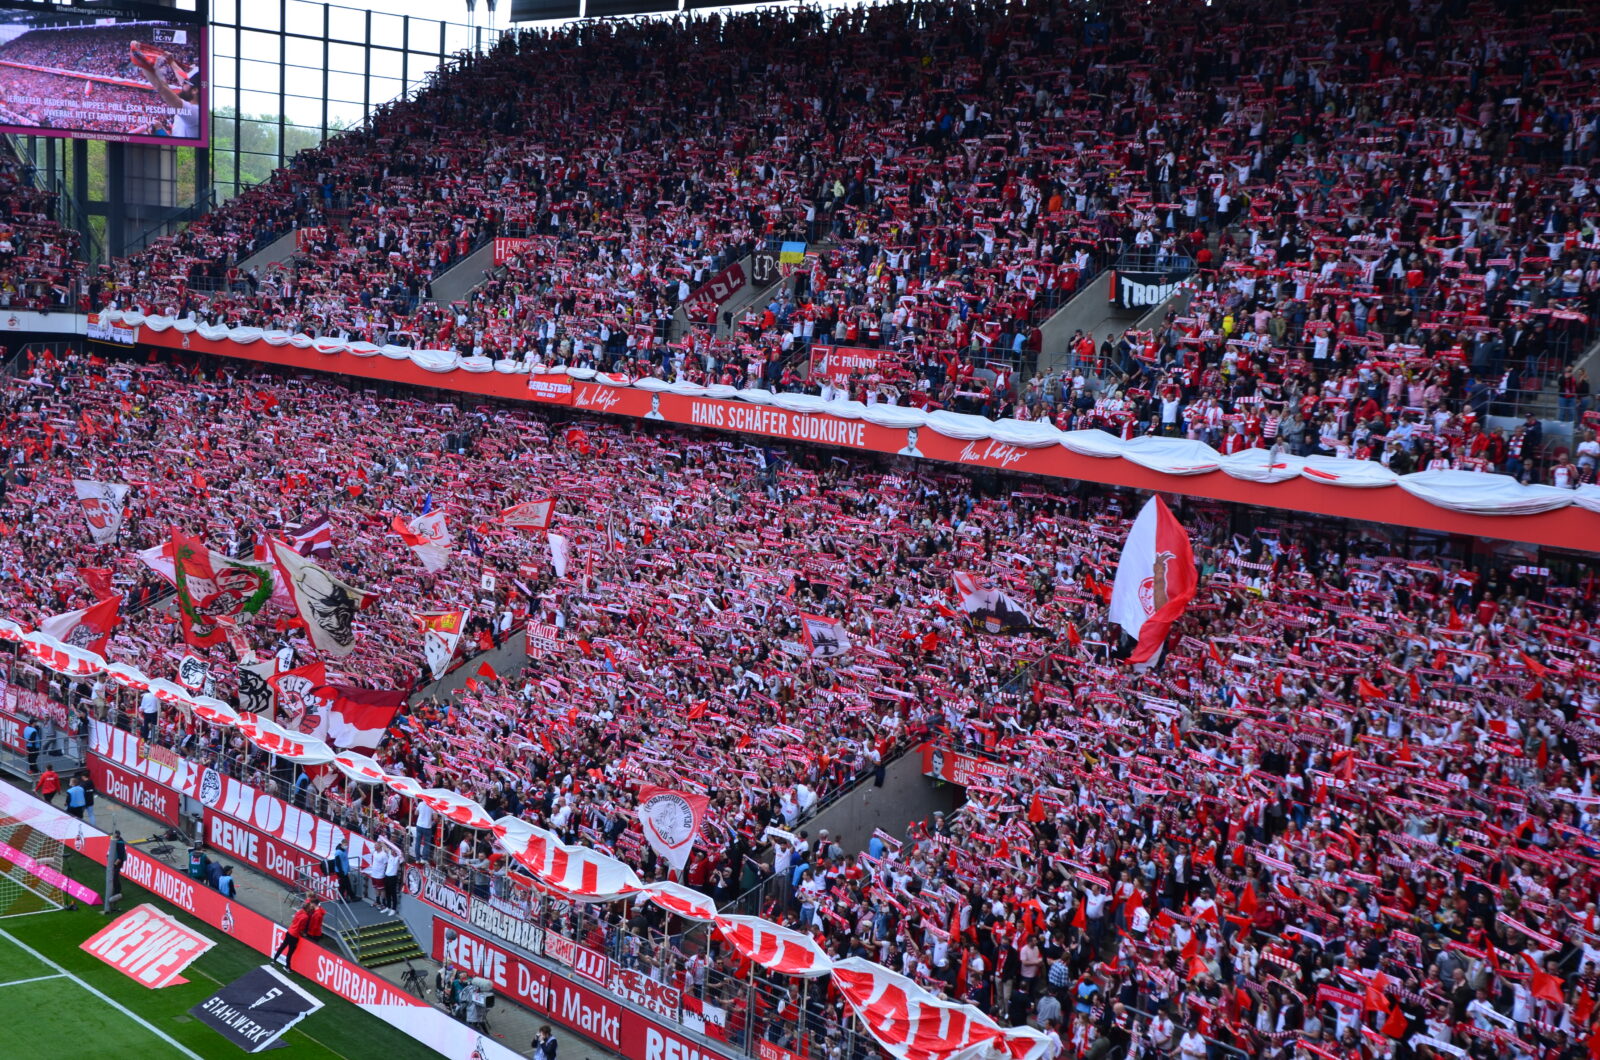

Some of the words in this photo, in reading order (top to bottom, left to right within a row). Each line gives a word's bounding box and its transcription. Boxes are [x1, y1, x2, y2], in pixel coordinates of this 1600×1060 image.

[829, 355, 840, 366] FC
[691, 402, 724, 426] HANS
[728, 406, 787, 435] SCHÄFER
[791, 413, 866, 446] SÜDKURVE
[106, 769, 130, 803] Dein
[132, 781, 167, 817] Markt
[211, 815, 259, 864] REWE
[266, 842, 295, 881] Dein
[300, 858, 341, 900] Markt
[153, 867, 195, 913] ANDERS.
[89, 910, 199, 984] REWE
[577, 951, 604, 980] AJJ
[316, 954, 377, 1006] SPÜRBAR
[444, 926, 507, 988] REWE
[517, 962, 557, 1013] Dein
[562, 986, 620, 1046] Markt
[608, 963, 679, 1008] FREAKS
[608, 981, 678, 1021] COLOGNE
